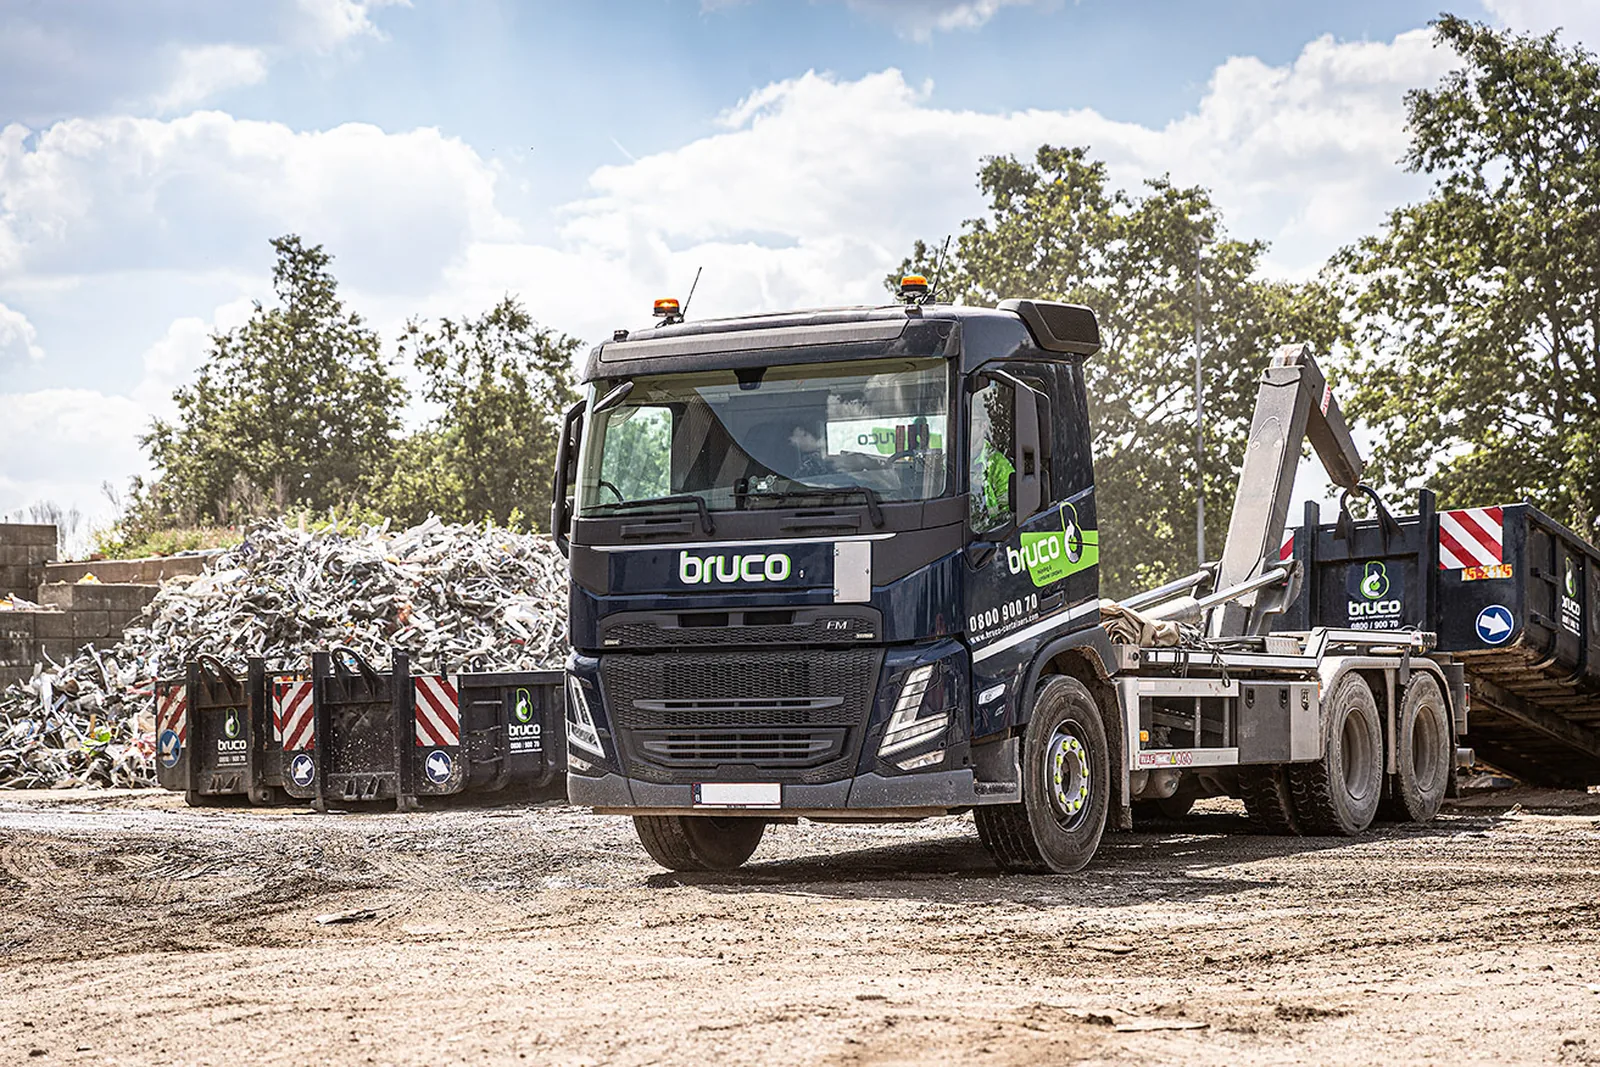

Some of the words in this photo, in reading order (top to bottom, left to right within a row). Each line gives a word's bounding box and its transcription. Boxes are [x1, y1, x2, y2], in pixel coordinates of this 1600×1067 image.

[1006, 536, 1060, 575] bruco
[680, 551, 791, 584] bruco
[970, 608, 999, 632] 0800
[1002, 599, 1022, 621] 900
[1024, 593, 1038, 612] 70
[1348, 600, 1401, 616] bruco
[826, 620, 848, 630] FM
[1374, 620, 1388, 629] 900
[1389, 620, 1399, 628] 70
[509, 723, 541, 736] bruco
[217, 739, 247, 751] bruco
